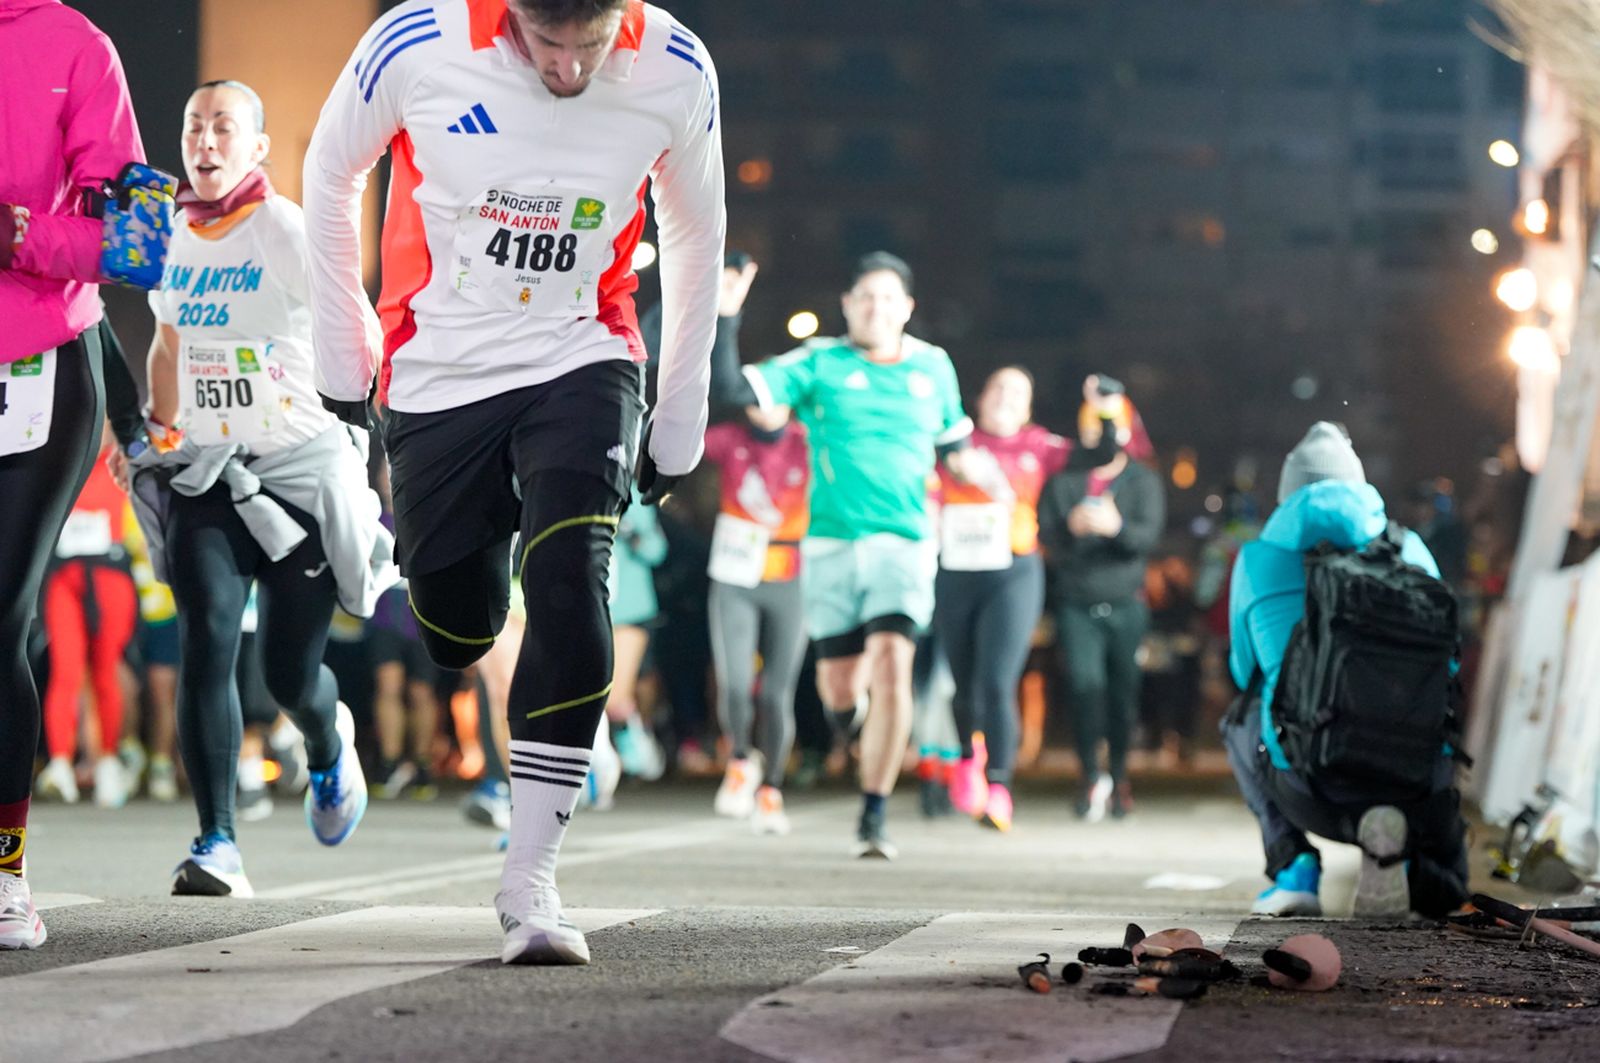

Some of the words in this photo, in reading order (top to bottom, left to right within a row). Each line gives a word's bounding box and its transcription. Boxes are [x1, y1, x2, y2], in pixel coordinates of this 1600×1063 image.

[500, 195, 544, 212] NOCHE
[546, 201, 562, 212] DE
[479, 205, 510, 224] SAN
[511, 214, 560, 230] ANTÓN
[485, 228, 577, 272] 4188
[190, 259, 262, 297] ANTÓN
[515, 274, 541, 284] Jesus
[178, 303, 229, 326] 2026
[196, 378, 253, 408] 6570
